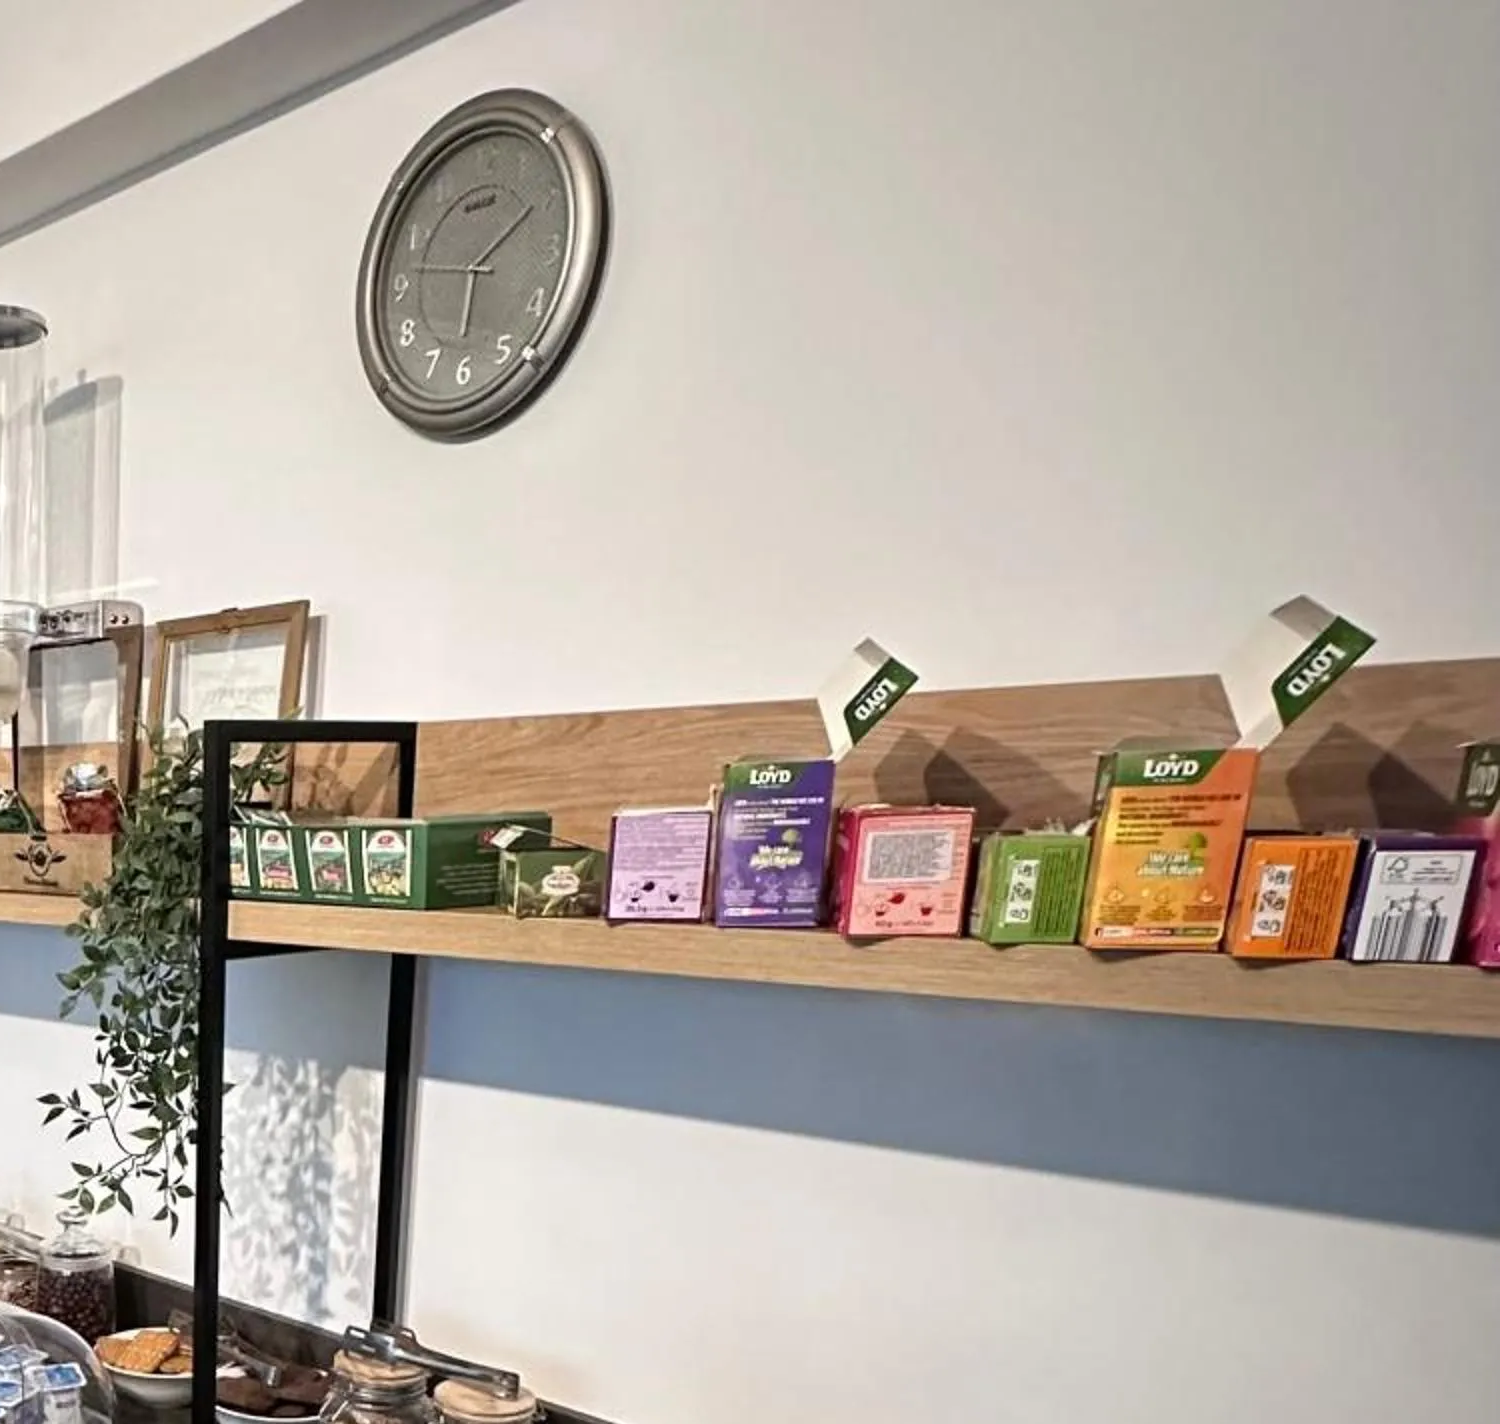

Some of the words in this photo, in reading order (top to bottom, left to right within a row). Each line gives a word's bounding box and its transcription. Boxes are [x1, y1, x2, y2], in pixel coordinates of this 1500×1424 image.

[393, 273, 409, 302] 9
[526, 287, 545, 317] 4
[399, 319, 416, 347] 8
[424, 347, 442, 381] 7
[494, 333, 513, 365] 5
[455, 355, 472, 385] 6
[1286, 643, 1347, 698] LOYD
[854, 677, 899, 721] LOYD
[749, 769, 792, 786] LOYD
[1142, 758, 1200, 778] LOYD
